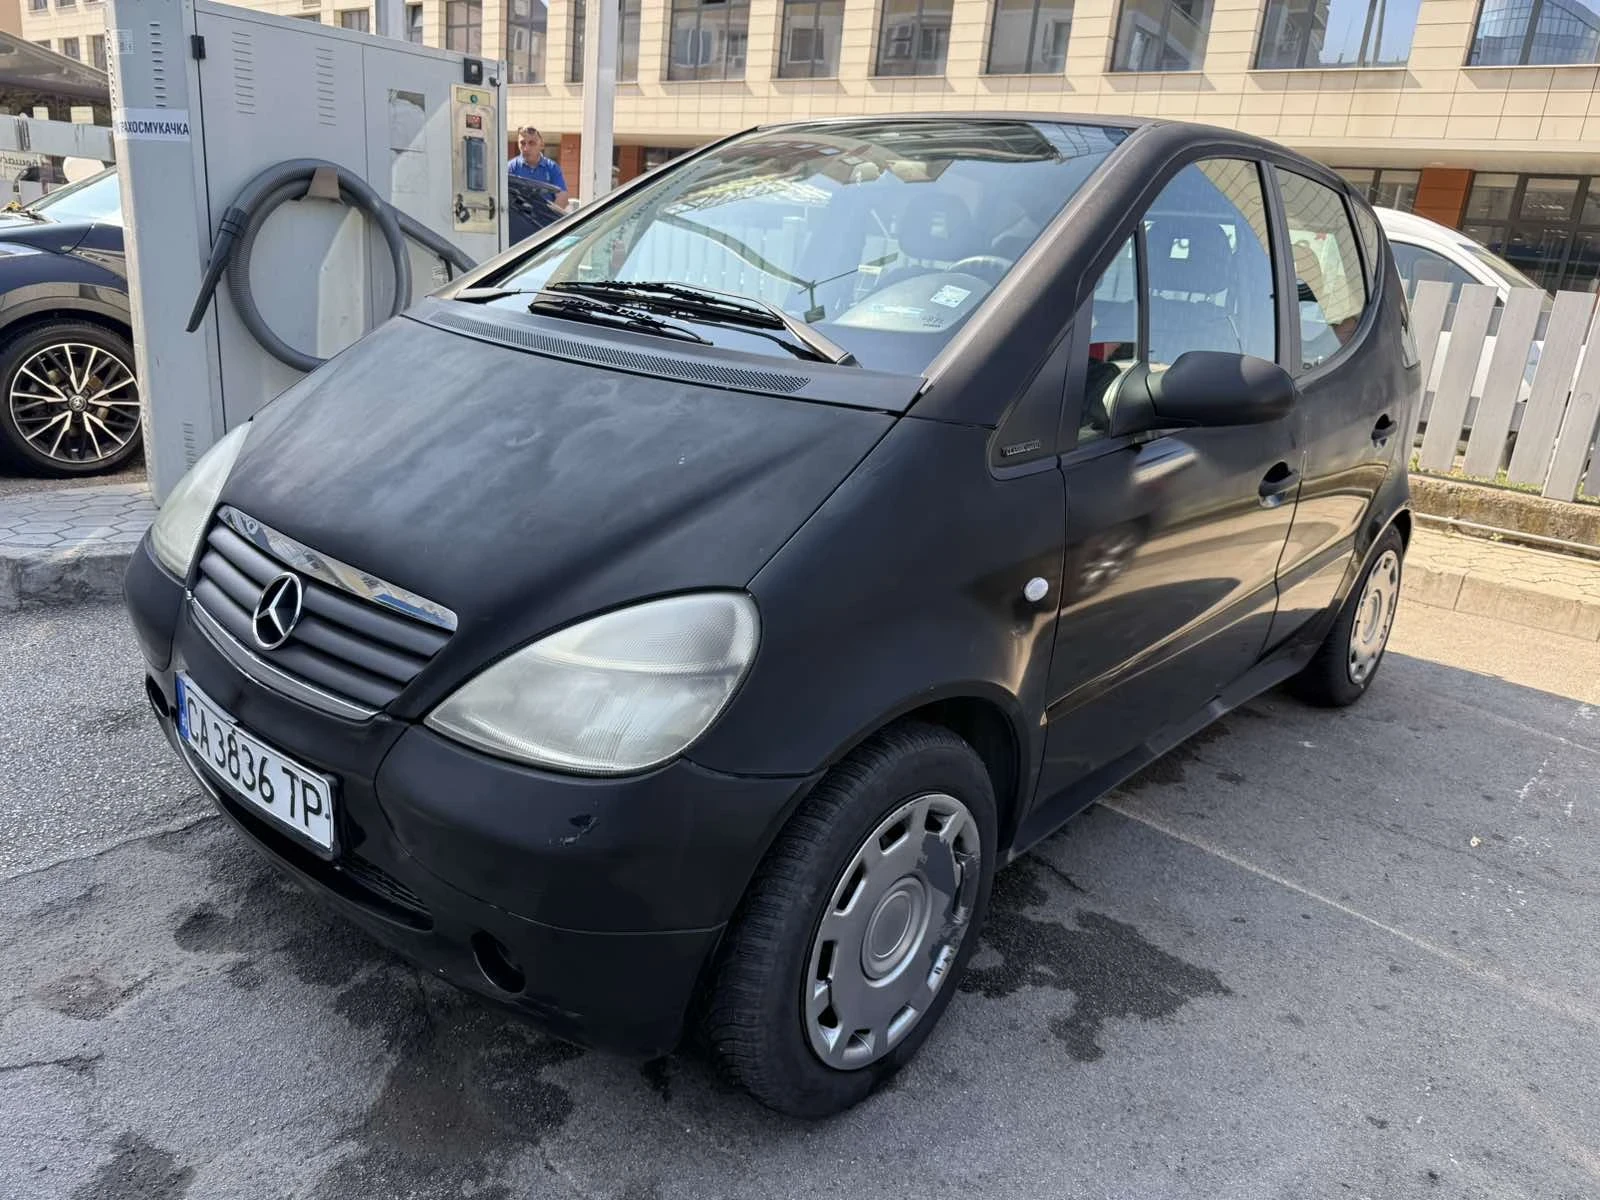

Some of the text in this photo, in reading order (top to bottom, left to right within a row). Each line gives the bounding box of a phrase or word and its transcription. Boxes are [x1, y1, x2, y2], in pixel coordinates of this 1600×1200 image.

[116, 121, 189, 135] РАХОСМУКАЧКА
[187, 696, 323, 827] CA 3836 TP
